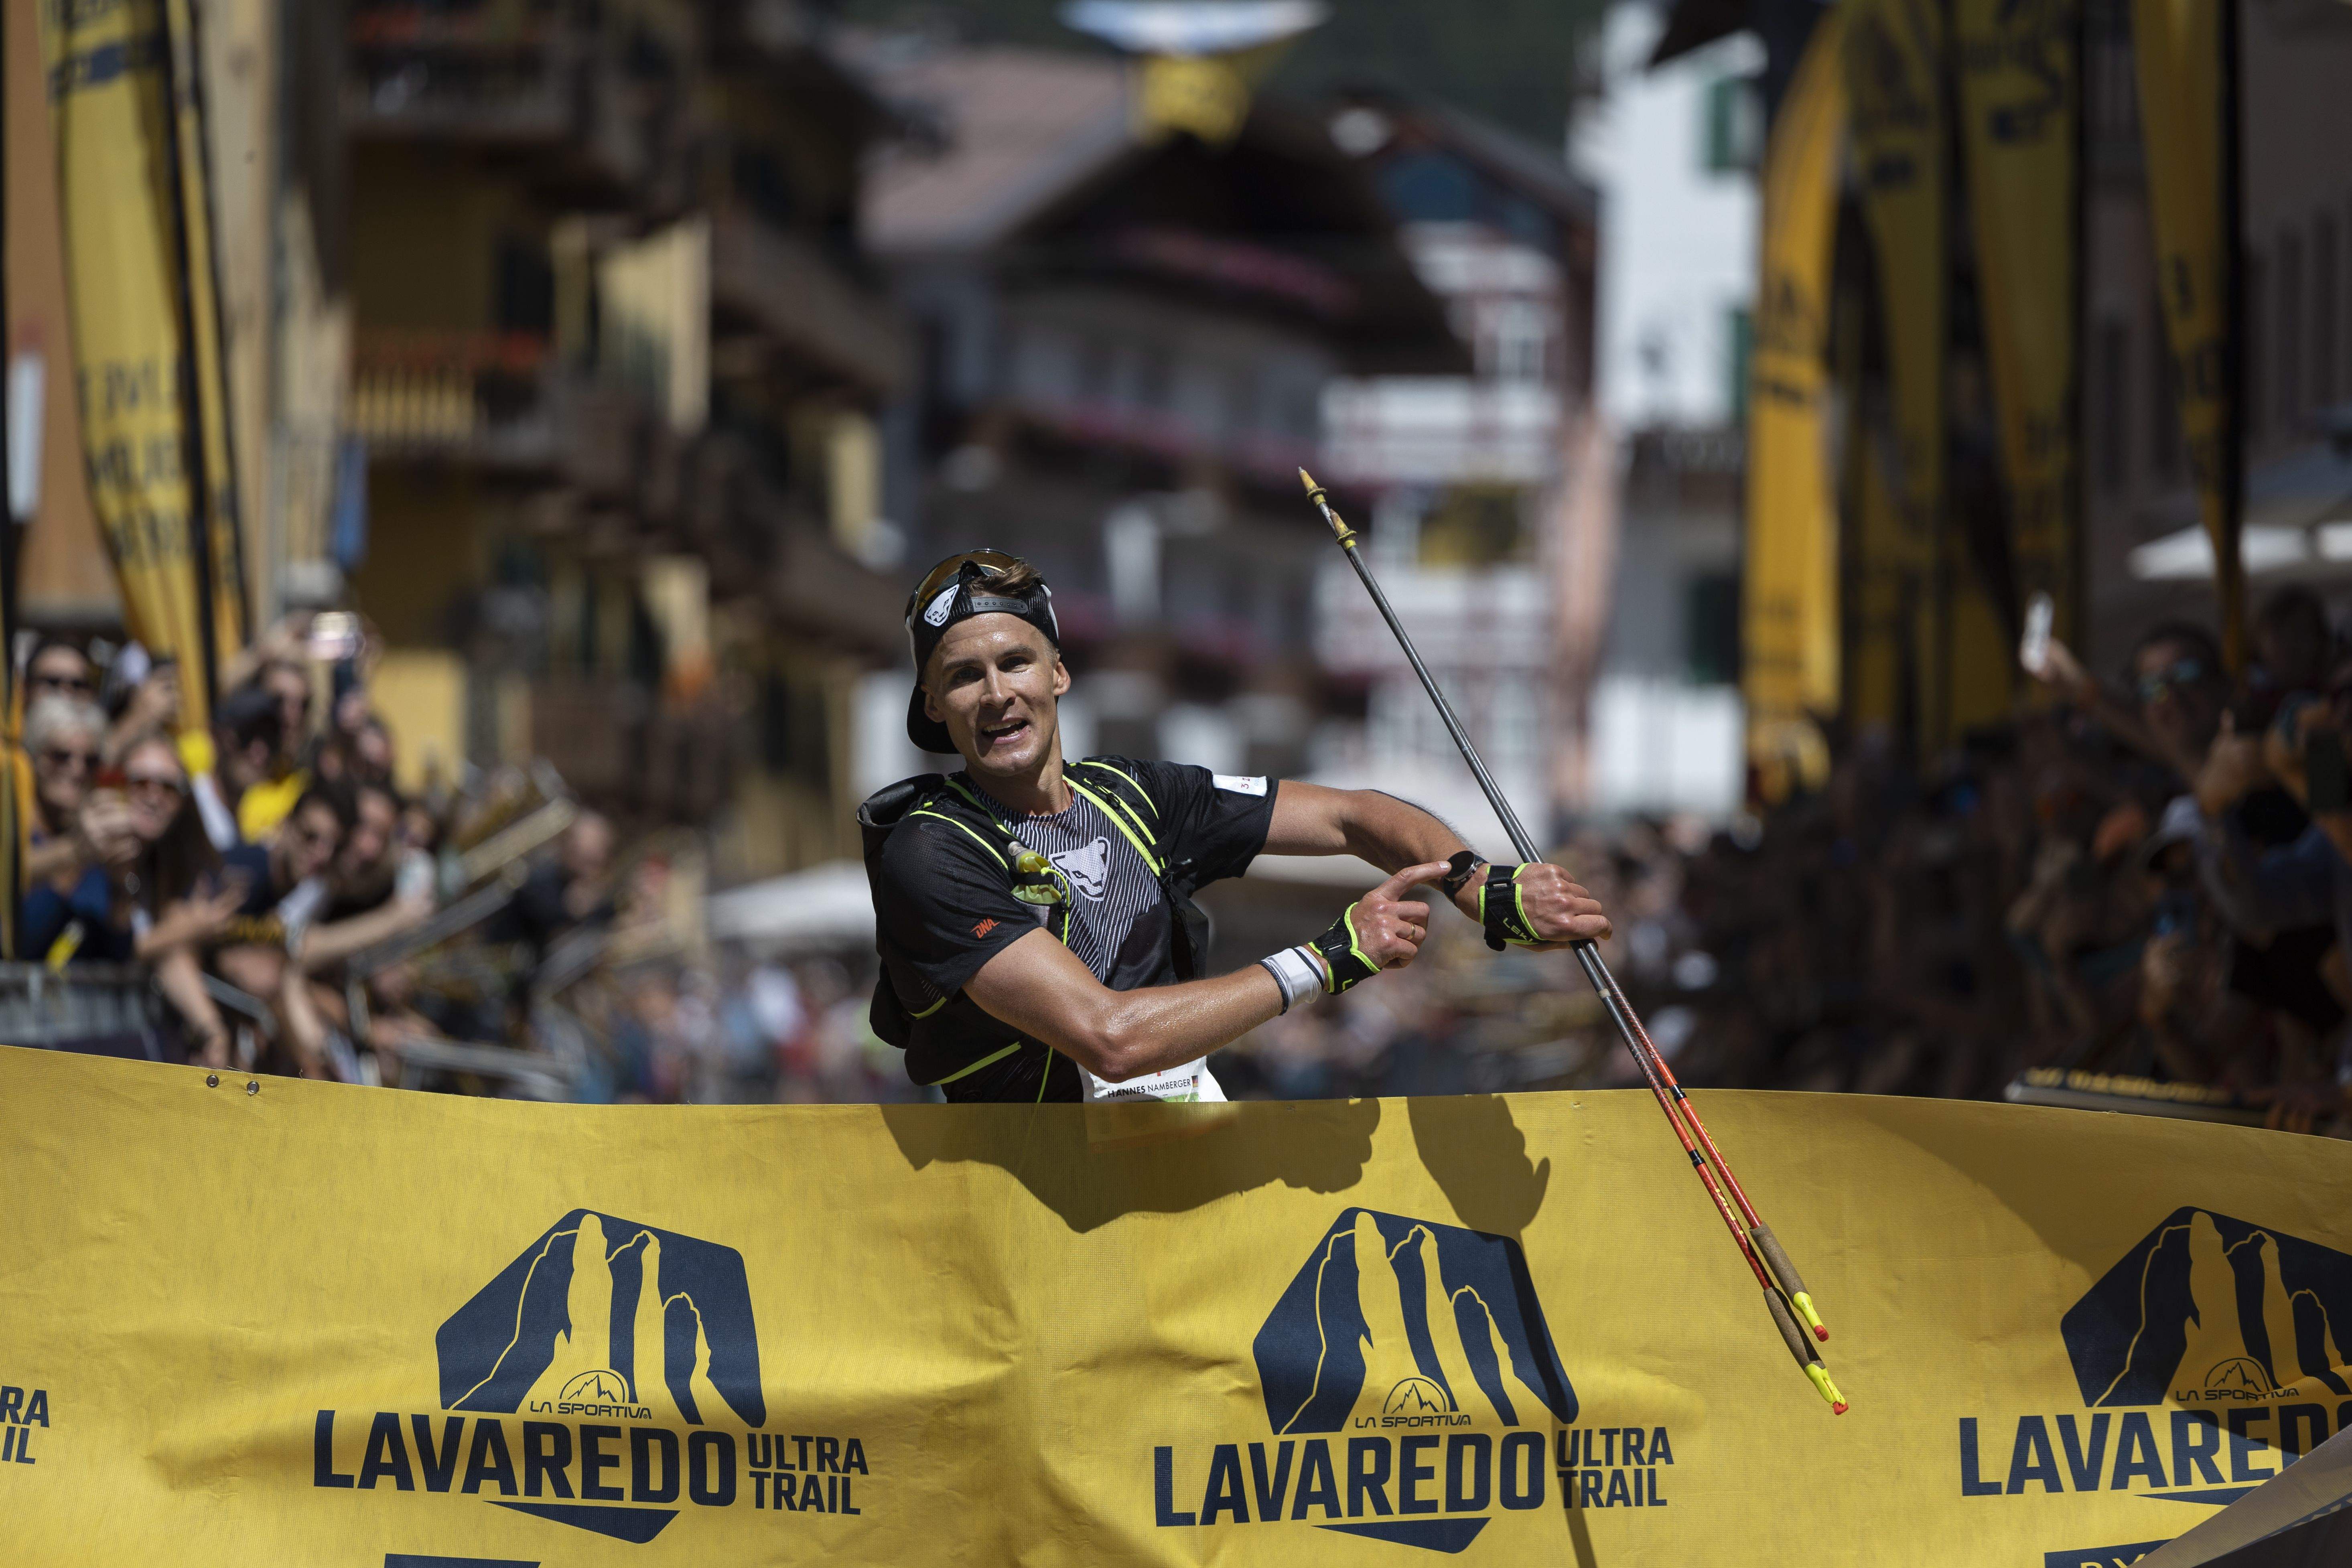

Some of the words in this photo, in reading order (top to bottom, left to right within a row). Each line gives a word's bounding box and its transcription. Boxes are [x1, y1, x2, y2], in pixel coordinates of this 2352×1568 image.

[970, 919, 1001, 938] DNA
[1108, 1085, 1146, 1098] HANNES
[1147, 1079, 1191, 1092] NAMBERGER
[530, 1401, 552, 1413] LA
[558, 1403, 652, 1419] SPORTIVA
[2176, 1390, 2200, 1401] LA
[2205, 1388, 2299, 1401] SPORTIVA
[1355, 1417, 1376, 1428] LA
[1381, 1414, 1471, 1427] SPORTIVA
[314, 1410, 736, 1507] LAVAREDO
[747, 1433, 869, 1475] ULTRA
[1557, 1427, 1674, 1467] ULTRA
[1960, 1403, 2352, 1496] LAVARED
[749, 1471, 861, 1515] TRAIL
[1155, 1431, 1546, 1527] LAVAREDO
[1557, 1468, 1667, 1509] TRAIL
